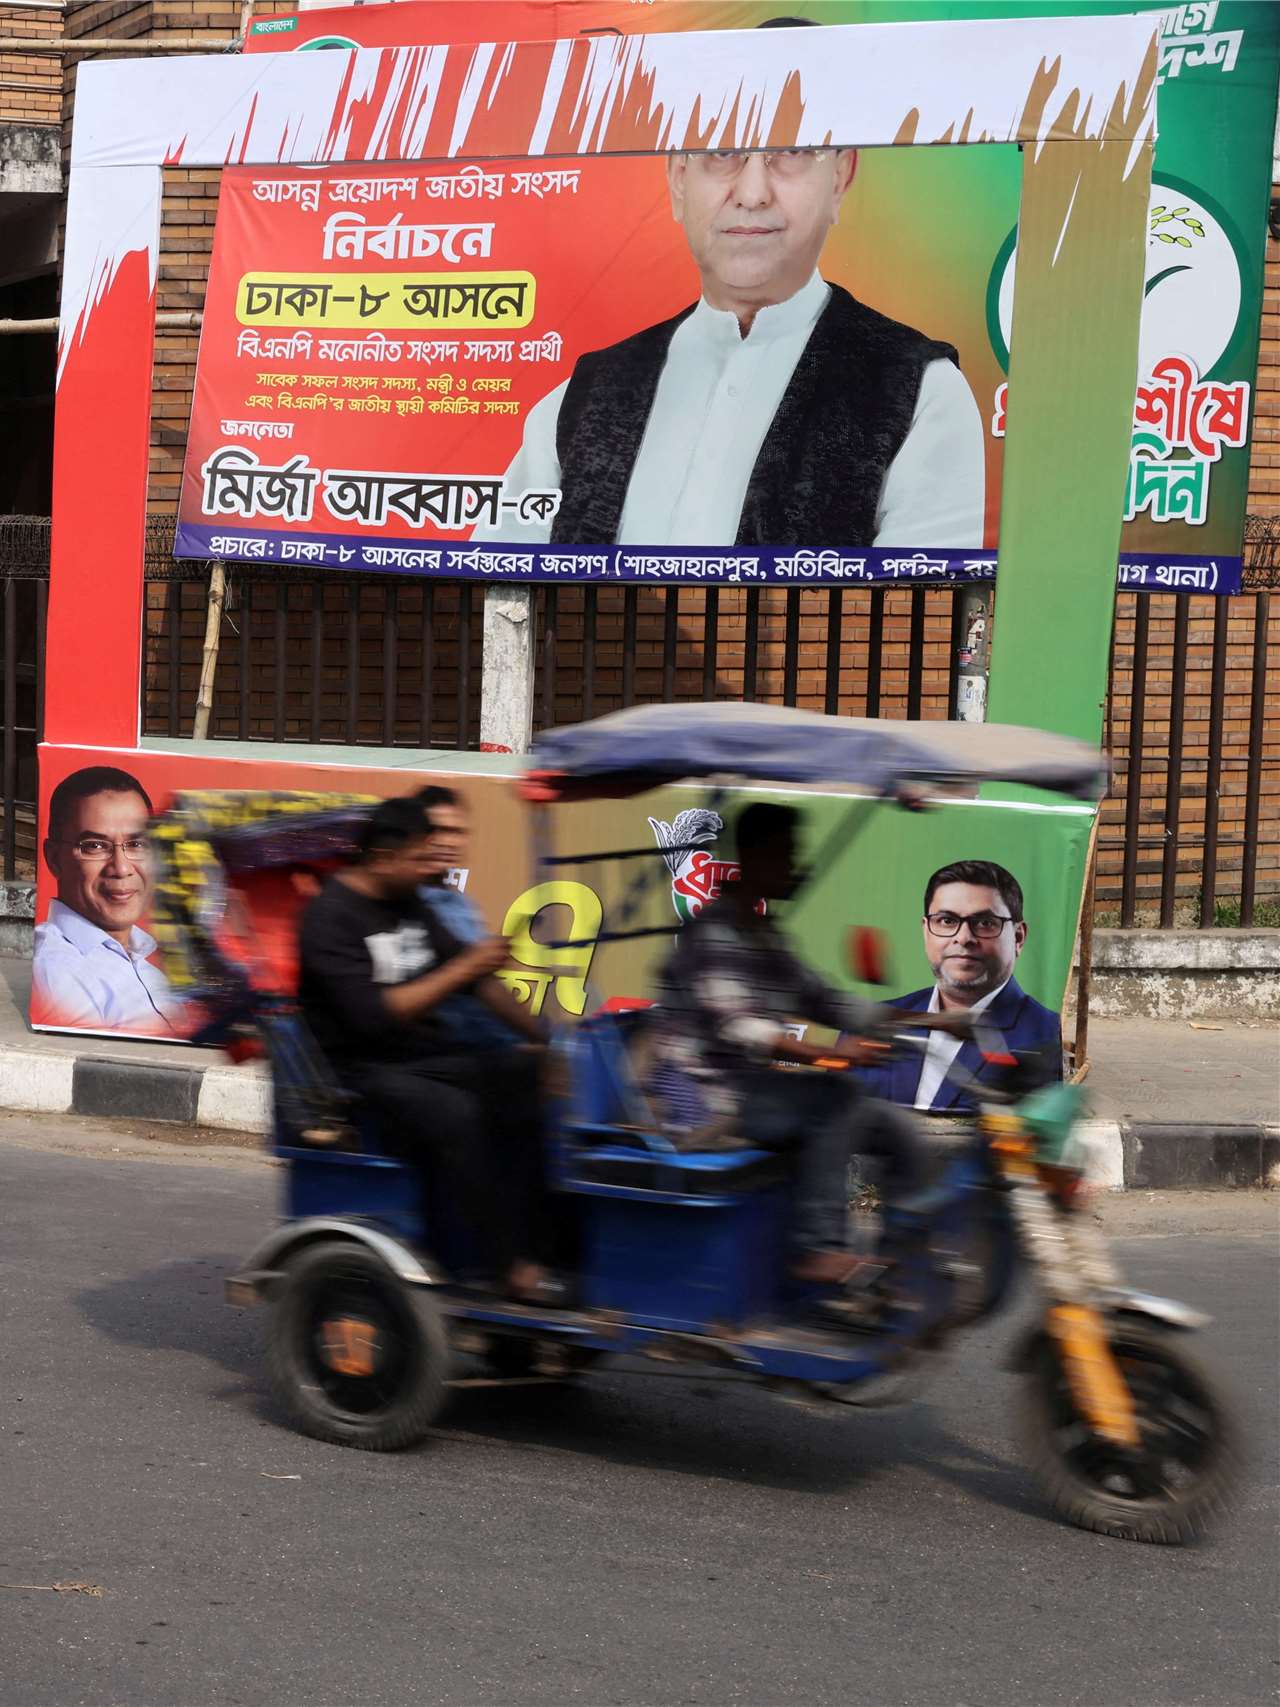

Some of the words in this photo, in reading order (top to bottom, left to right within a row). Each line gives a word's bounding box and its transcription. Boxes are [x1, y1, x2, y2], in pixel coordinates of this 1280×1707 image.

[255, 19, 294, 32] বাংলাদেশ
[252, 179, 322, 212] আসন্ন
[328, 177, 418, 204] ত্রয়োদশ
[424, 165, 505, 200] জাতীয়
[510, 170, 581, 198] সংসদ
[321, 211, 495, 263] নির্বাচনে
[246, 282, 390, 318] ঢাকা-৮
[402, 282, 528, 319] আসনে
[236, 329, 313, 360] বিএনপি
[318, 332, 404, 363] মনোনীত
[406, 341, 460, 366] সংসদ
[463, 341, 515, 363] সদস্য
[518, 331, 563, 363] প্রার্থী
[256, 373, 298, 388] সাবেক
[301, 375, 338, 389] সফল
[341, 376, 379, 391] সংসদ
[426, 373, 454, 394] মন্ত্রী
[456, 378, 467, 392] ও
[472, 378, 512, 393] মেয়র
[245, 395, 273, 409] এবং
[348, 395, 392, 414] জাতীয়
[395, 395, 425, 417] স্থায়ী
[428, 396, 480, 415] কমিটির
[483, 401, 520, 416] সদস্য
[221, 420, 294, 440] জননেতা
[205, 447, 317, 519] মির্জা
[280, 539, 355, 563] ঢাকা-৮
[361, 545, 442, 570] আসনের
[447, 546, 534, 574] সর্বস্তরের
